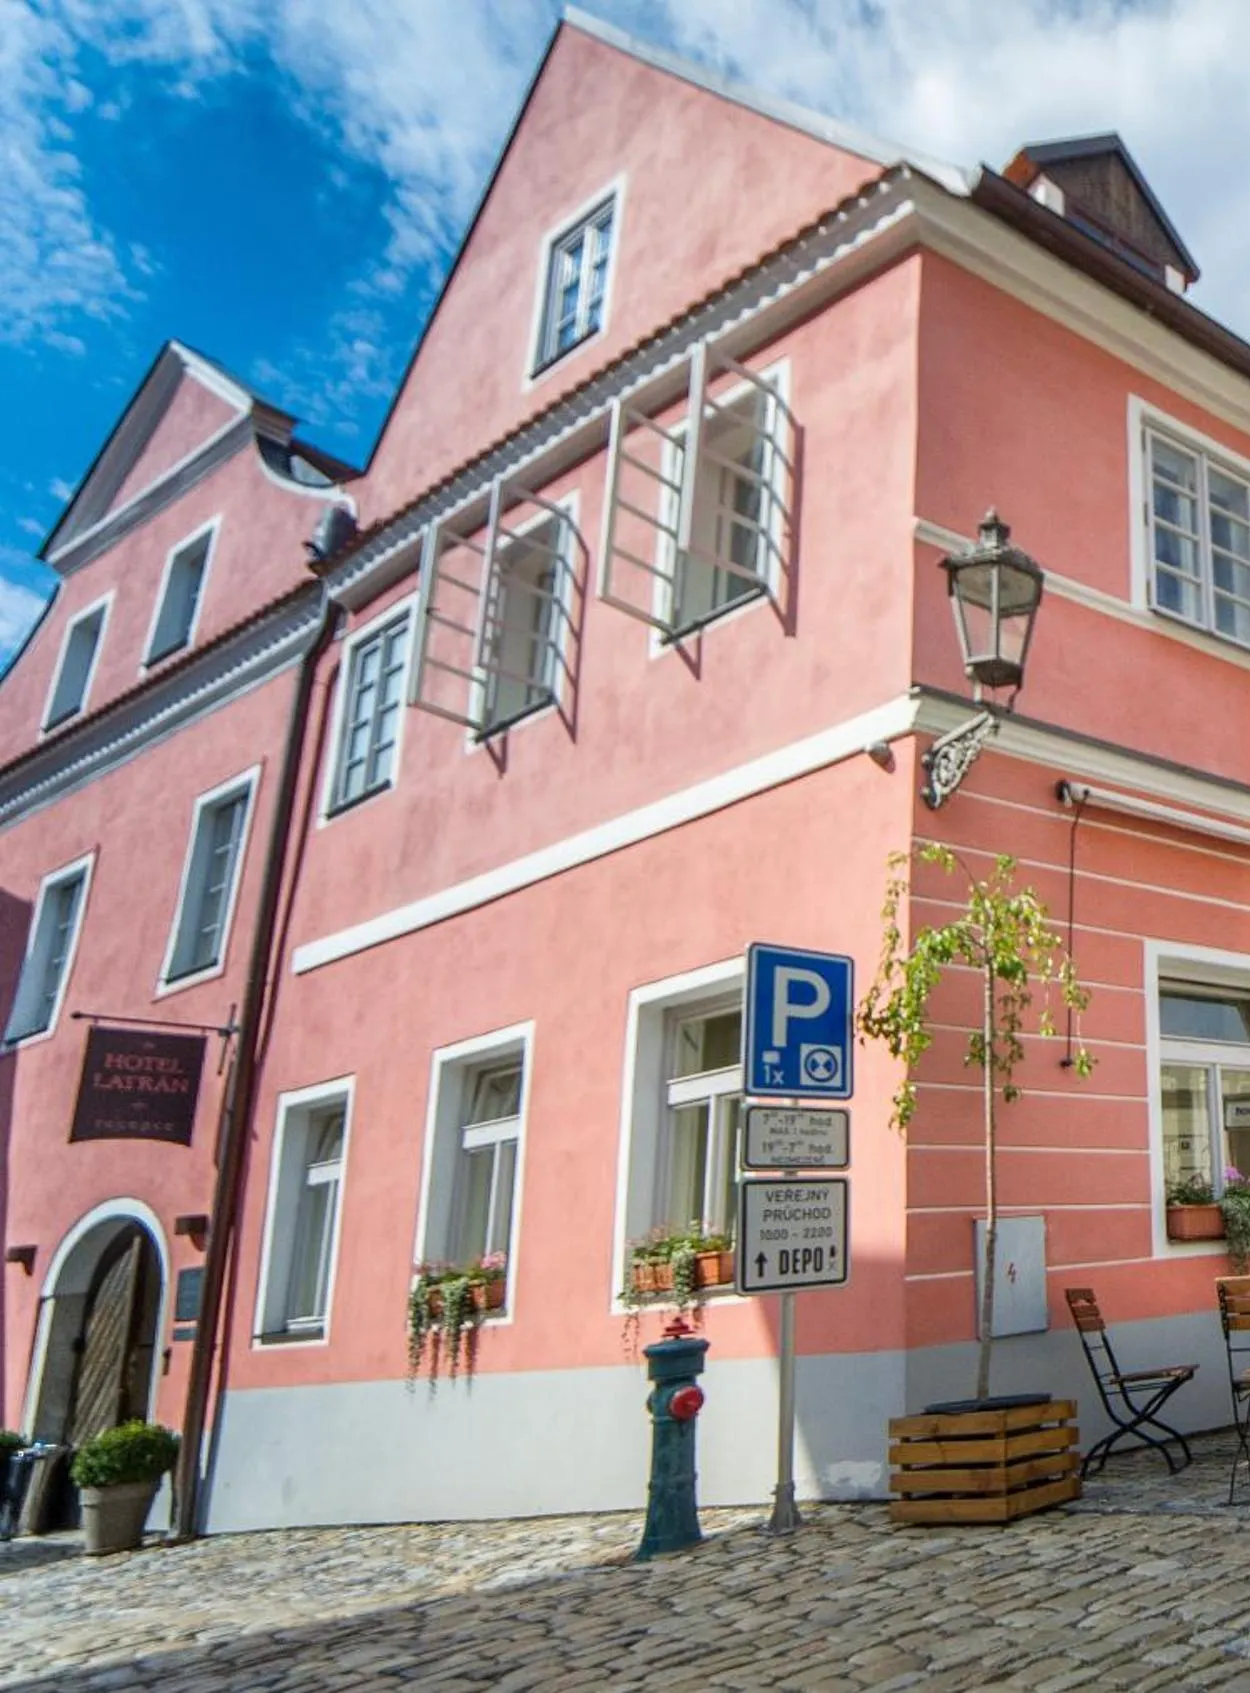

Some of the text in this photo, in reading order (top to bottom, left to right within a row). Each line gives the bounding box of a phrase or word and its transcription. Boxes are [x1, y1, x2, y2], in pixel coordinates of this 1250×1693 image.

[772, 965, 831, 1048] P
[104, 1053, 184, 1074] HOTEL
[779, 1246, 824, 1275] DEPO
